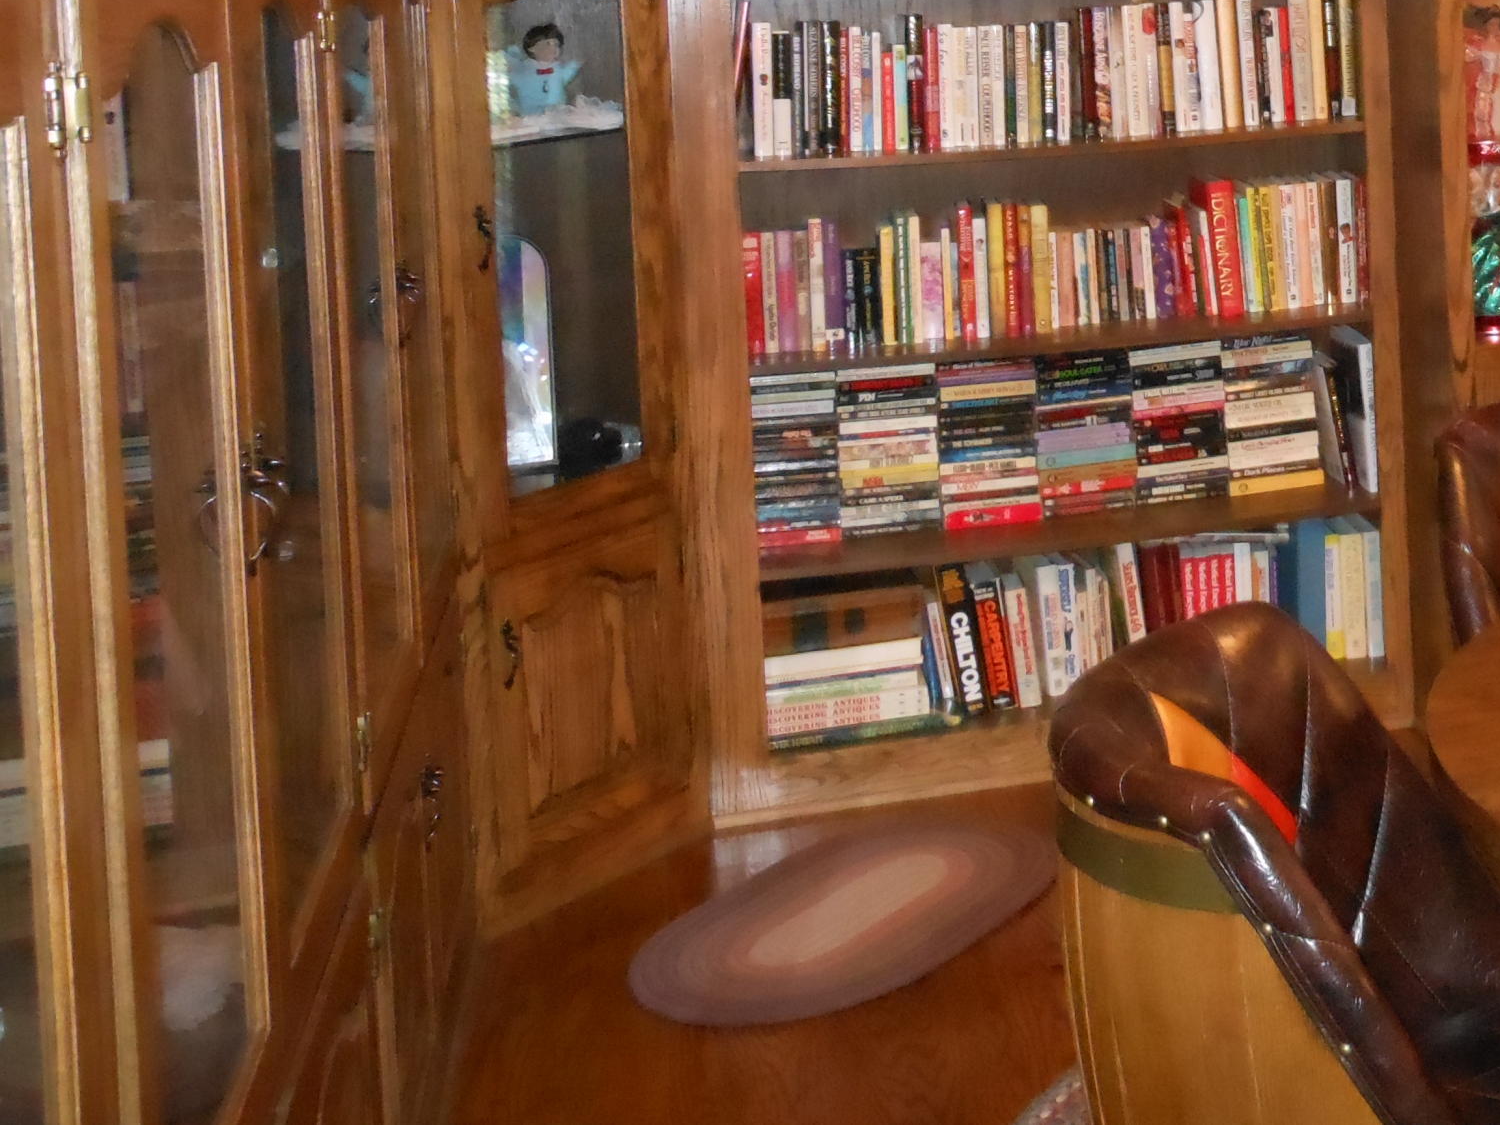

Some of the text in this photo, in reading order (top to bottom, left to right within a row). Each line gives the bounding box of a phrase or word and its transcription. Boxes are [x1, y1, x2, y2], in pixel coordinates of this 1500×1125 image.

[808, 26, 818, 62] SUZANNE
[1210, 197, 1233, 298] DICTIONARY
[1184, 562, 1194, 589] Medical
[1198, 562, 1207, 587] Medical
[1211, 559, 1219, 586] Medical
[1225, 558, 1233, 585] Medical
[950, 611, 983, 703] CHILTON
[984, 600, 1010, 693] CARPENTRY
[768, 695, 881, 716] ISCOVERING ANTIQUES
[768, 704, 881, 724] ISCOVERING ANTIQUES
[834, 713, 881, 725] ANTIQUES
